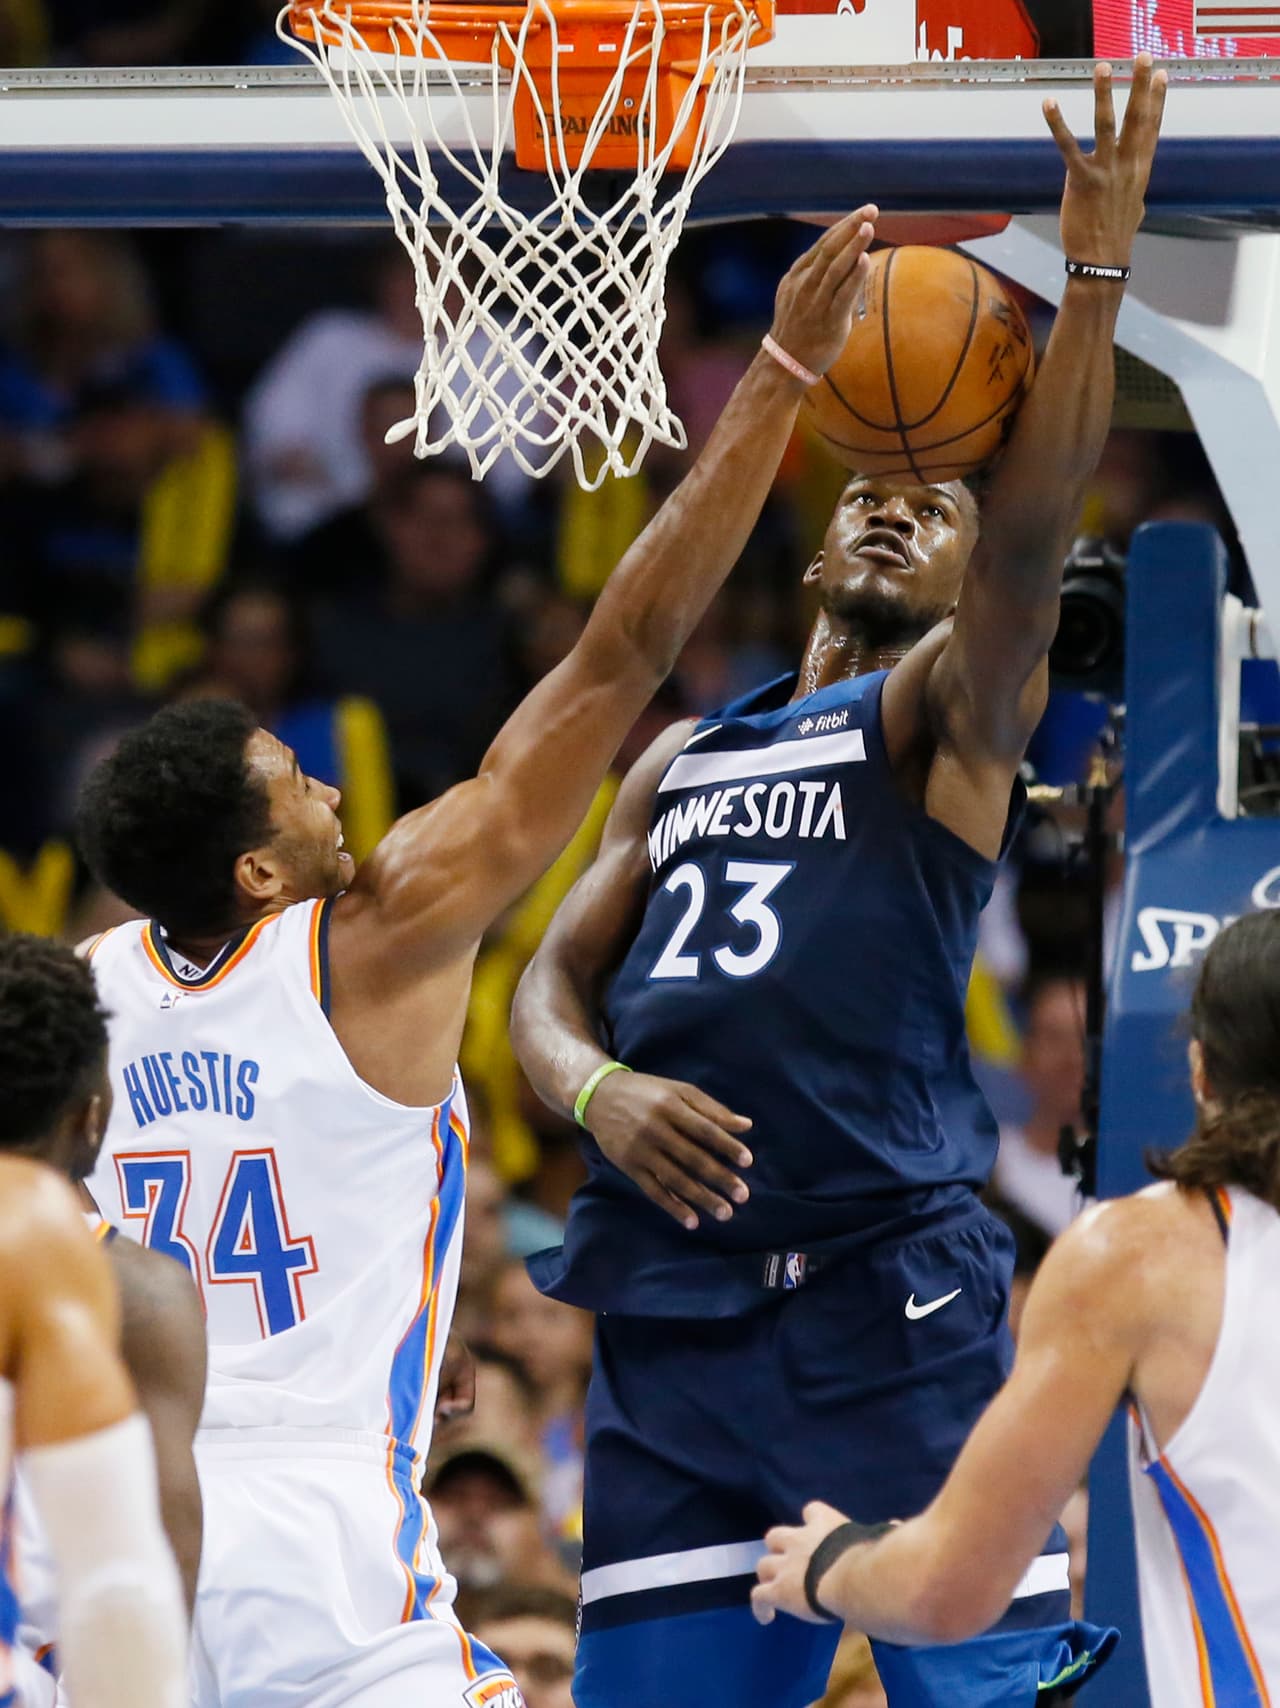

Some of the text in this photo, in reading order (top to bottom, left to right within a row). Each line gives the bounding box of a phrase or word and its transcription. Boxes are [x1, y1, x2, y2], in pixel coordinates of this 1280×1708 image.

[815, 709, 849, 732] fitbit
[647, 781, 847, 873] MINNESOTA
[647, 859, 798, 981] 23
[122, 1050, 260, 1128] HUESTIS
[112, 1147, 320, 1341] 34
